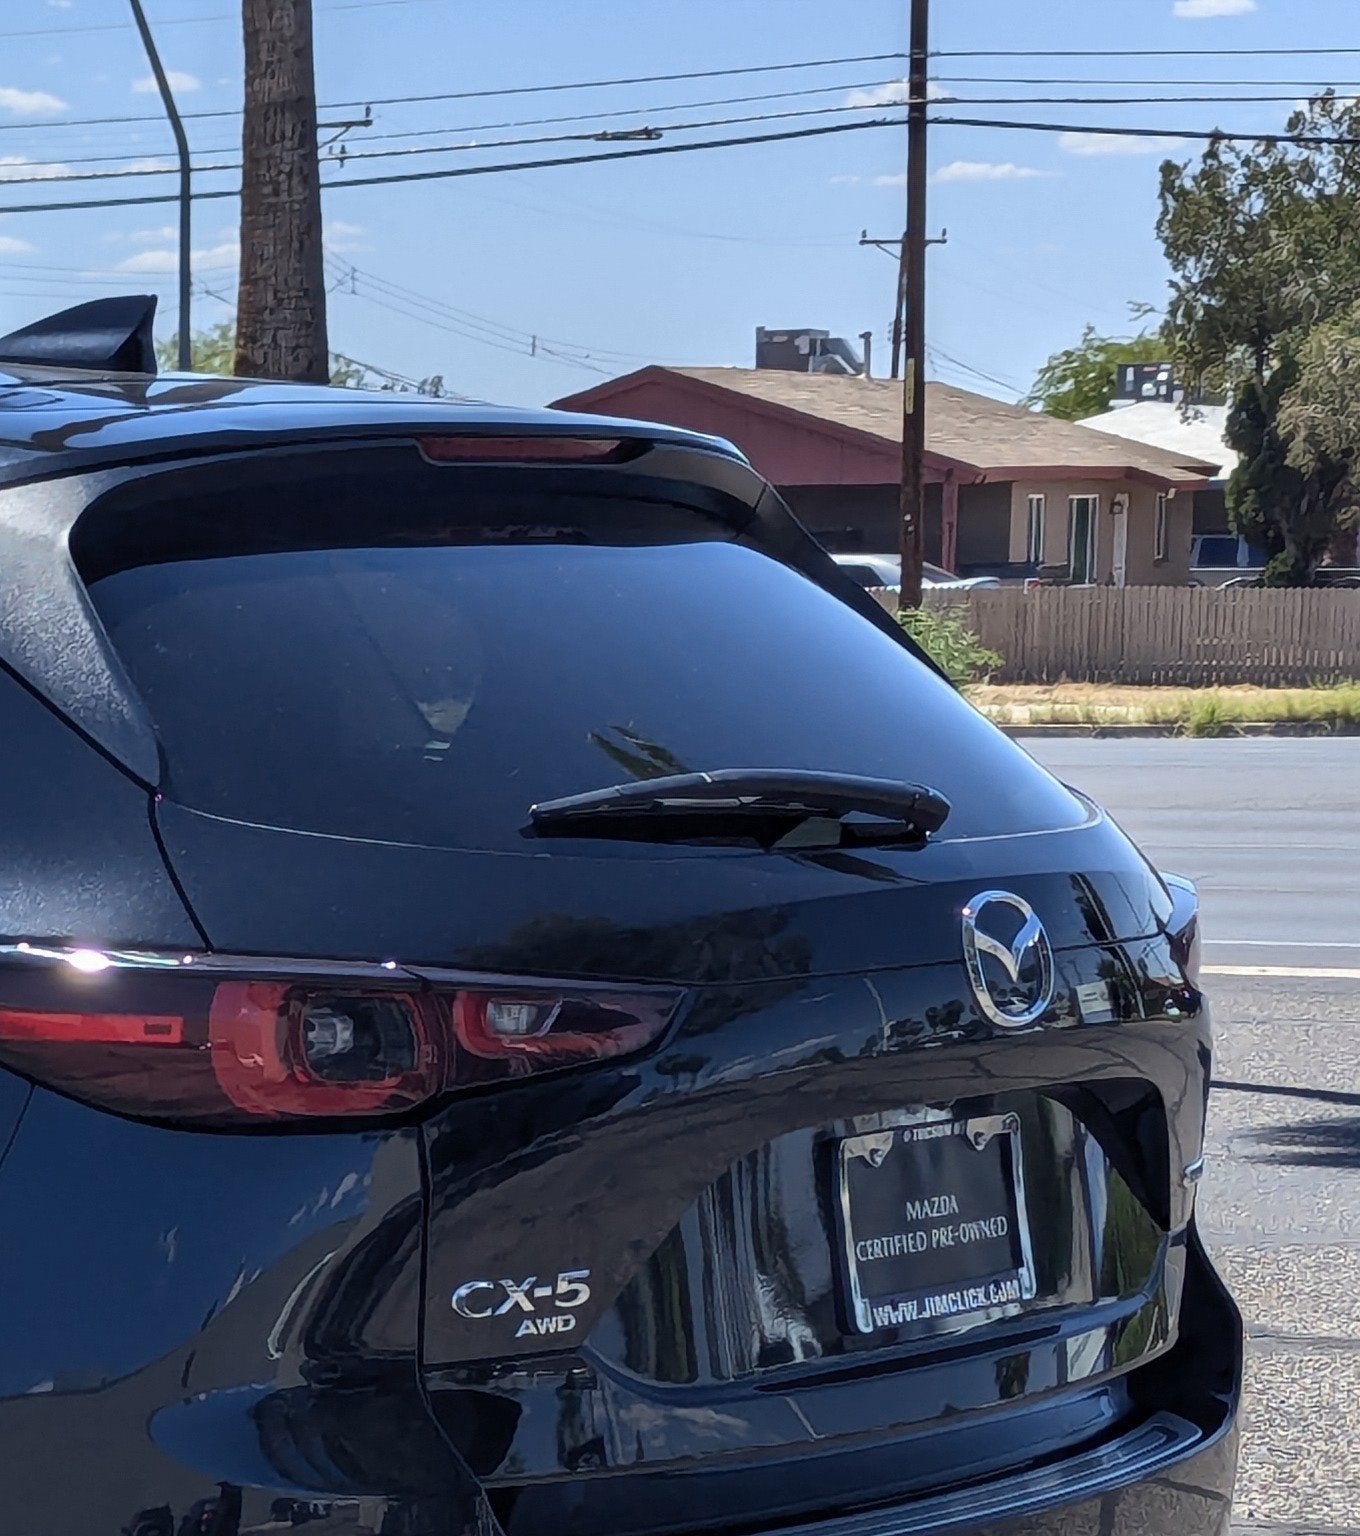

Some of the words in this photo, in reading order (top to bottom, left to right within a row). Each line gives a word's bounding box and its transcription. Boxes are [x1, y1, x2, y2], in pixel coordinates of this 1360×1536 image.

[906, 1195, 959, 1221] MAZDA
[856, 1231, 927, 1261] CERTIFIED
[932, 1216, 1008, 1249] PRE-OWNED
[451, 1269, 591, 1318] CX-5
[514, 1314, 576, 1337] AWD
